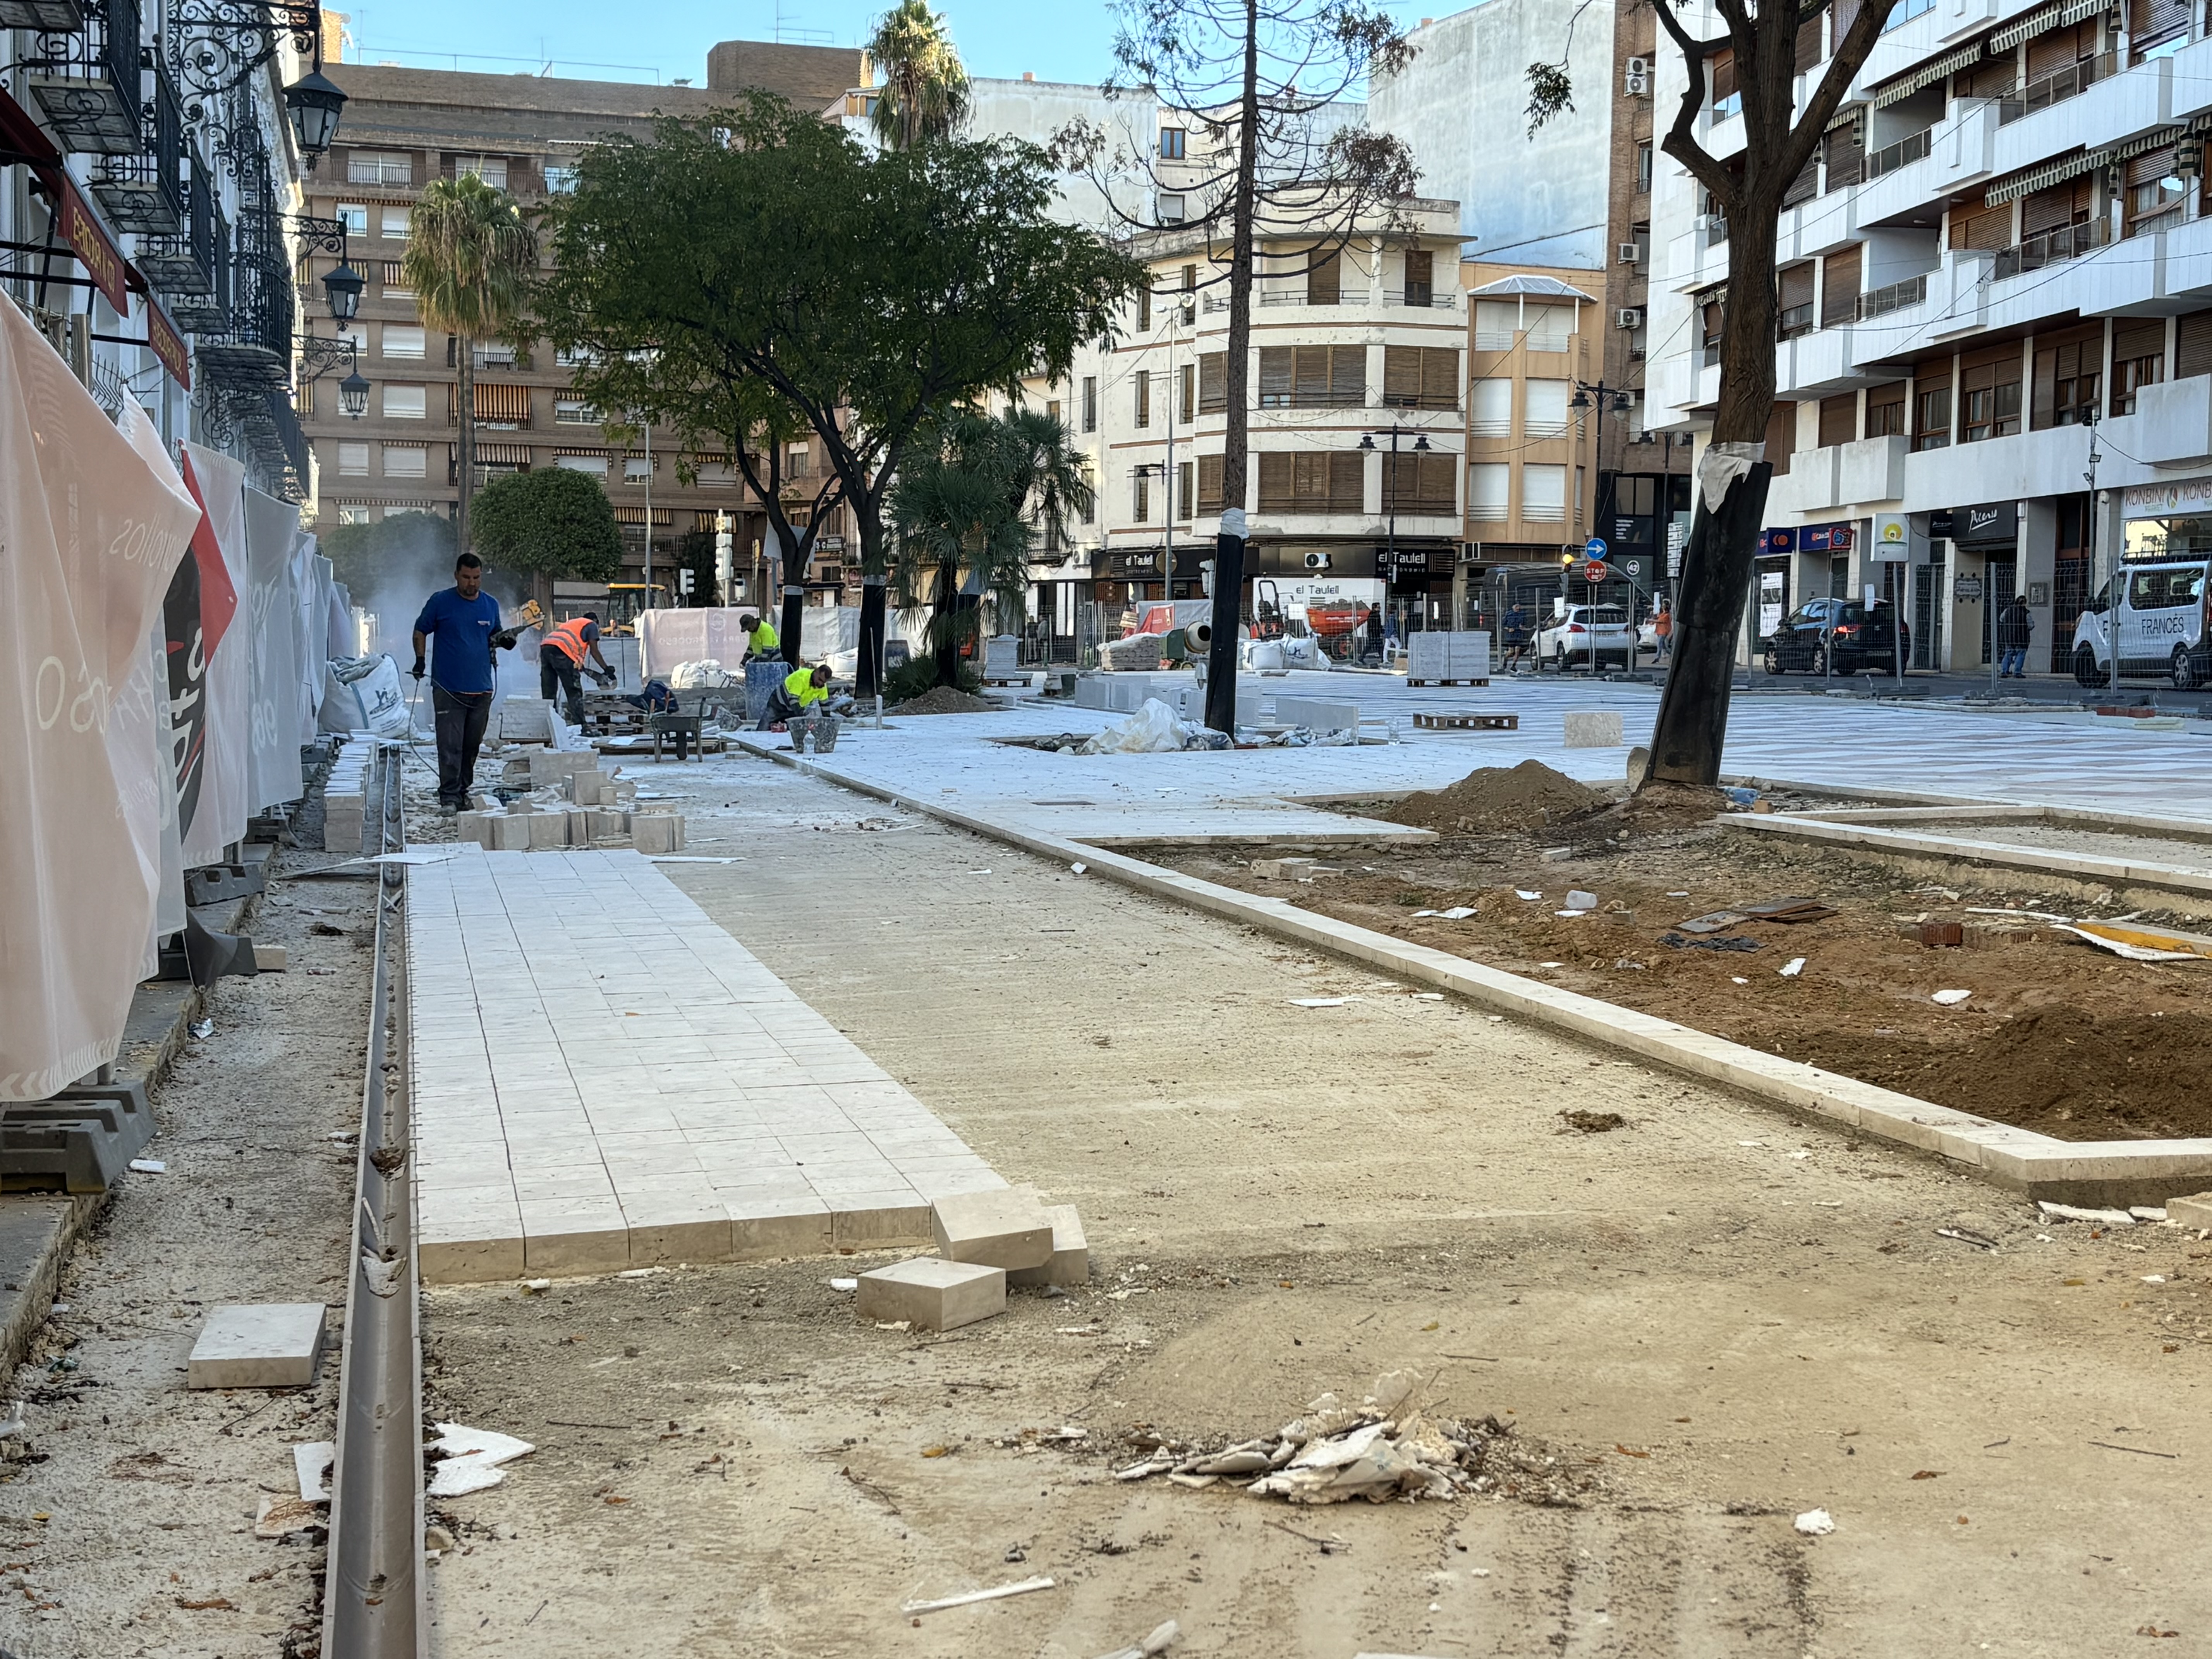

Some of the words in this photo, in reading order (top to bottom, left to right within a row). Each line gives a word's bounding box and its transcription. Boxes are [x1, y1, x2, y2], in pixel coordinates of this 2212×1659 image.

[2125, 487, 2166, 507] KONBINI
[1393, 551, 1425, 564] Taulell
[1296, 585, 1304, 594] el
[1309, 585, 1340, 594] Taulell
[2142, 613, 2184, 635] FRANCÉS
